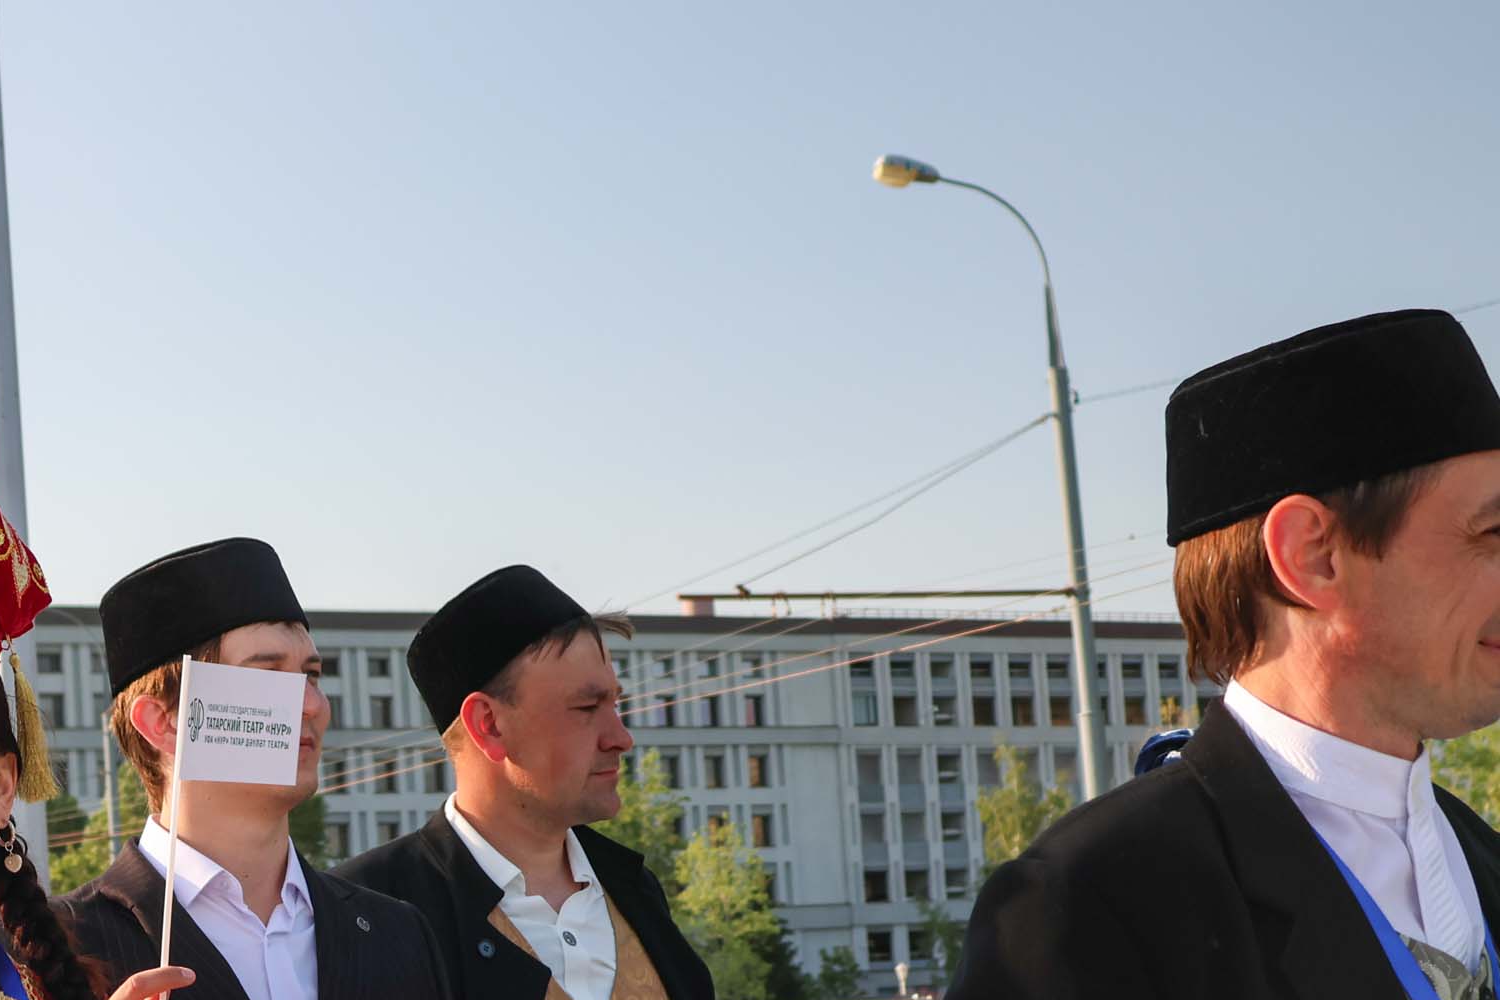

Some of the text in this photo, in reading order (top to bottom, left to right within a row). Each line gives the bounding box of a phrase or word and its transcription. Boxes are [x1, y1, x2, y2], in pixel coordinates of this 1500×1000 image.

[206, 716, 292, 736] ТАТАРСКИЙ ТЕАТР «НУР»
[230, 737, 245, 746] ТАТАР
